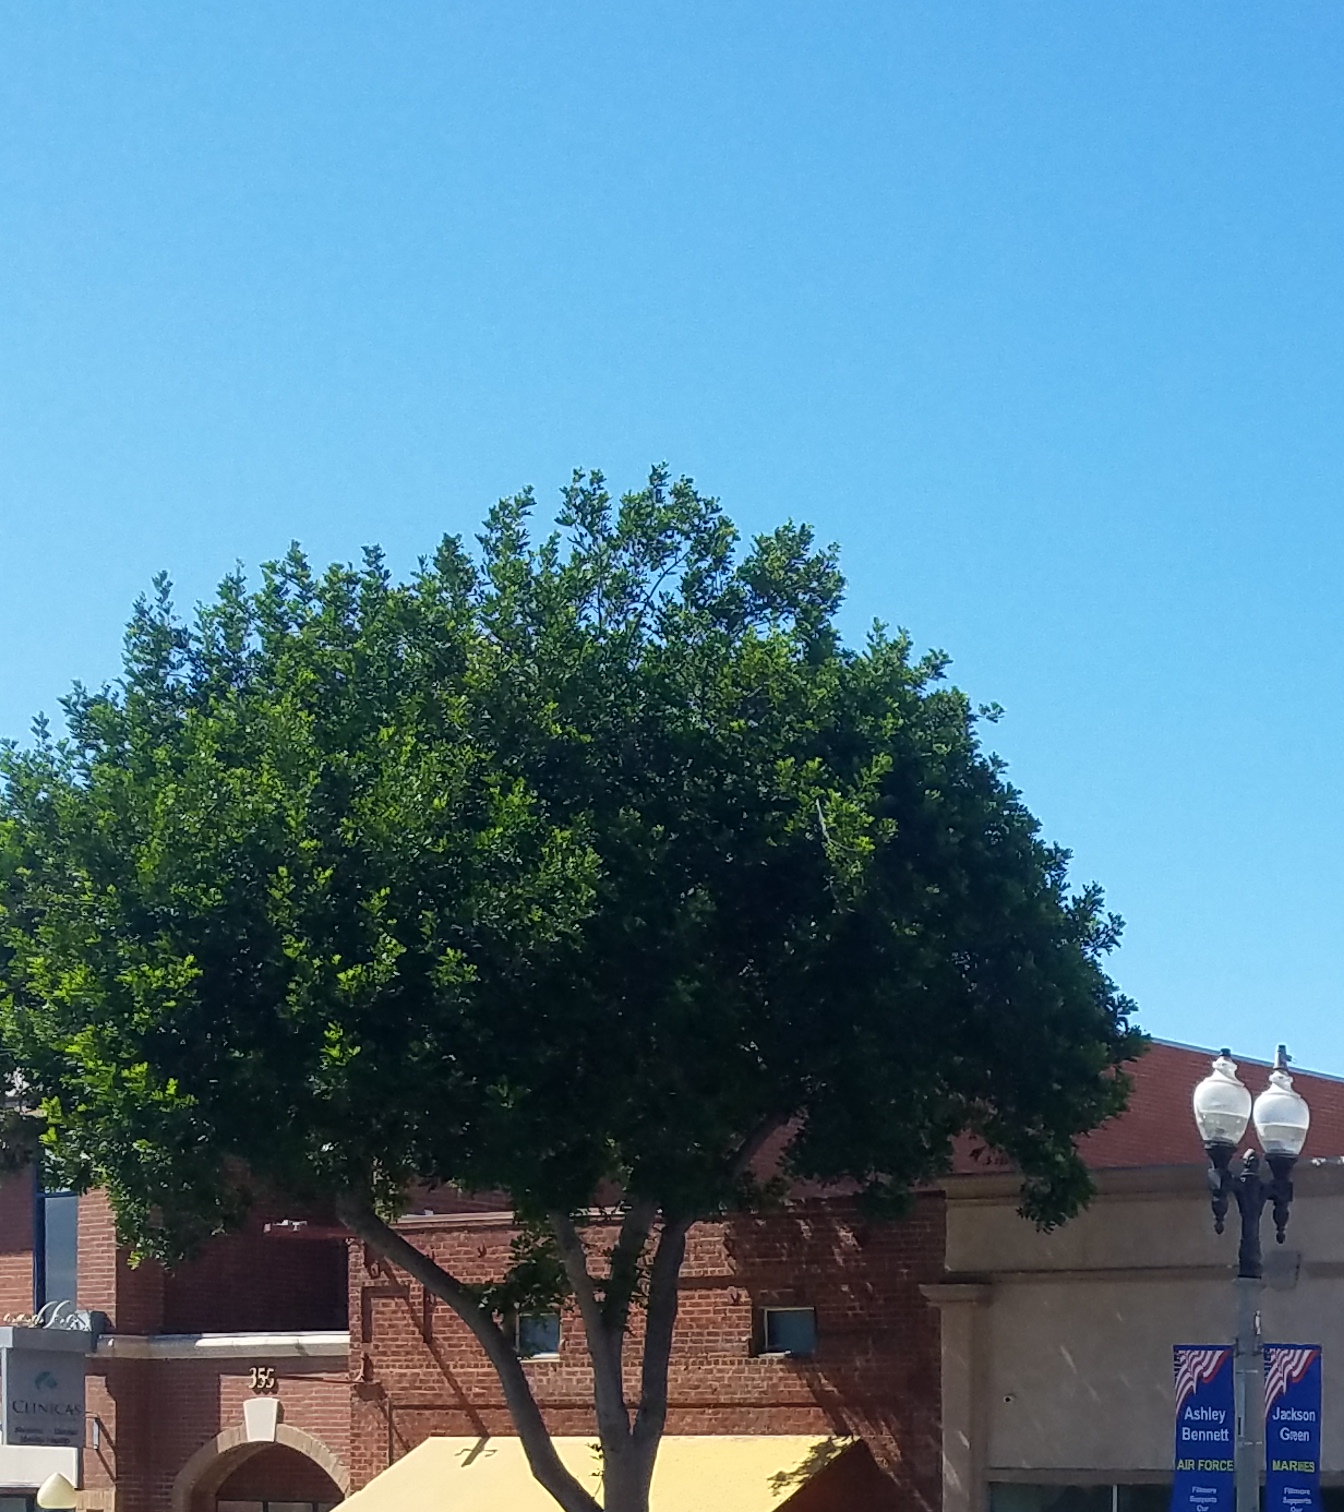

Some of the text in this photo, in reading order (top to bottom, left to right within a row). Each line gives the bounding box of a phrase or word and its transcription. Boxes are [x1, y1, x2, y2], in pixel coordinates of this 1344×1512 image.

[12, 1399, 83, 1416] CLINICAS
[1184, 1406, 1226, 1424] Ashley
[1272, 1406, 1316, 1421] Jackson
[1182, 1427, 1229, 1442] Bennett
[1279, 1427, 1310, 1442] Green
[1177, 1459, 1234, 1472] AIR FORCE
